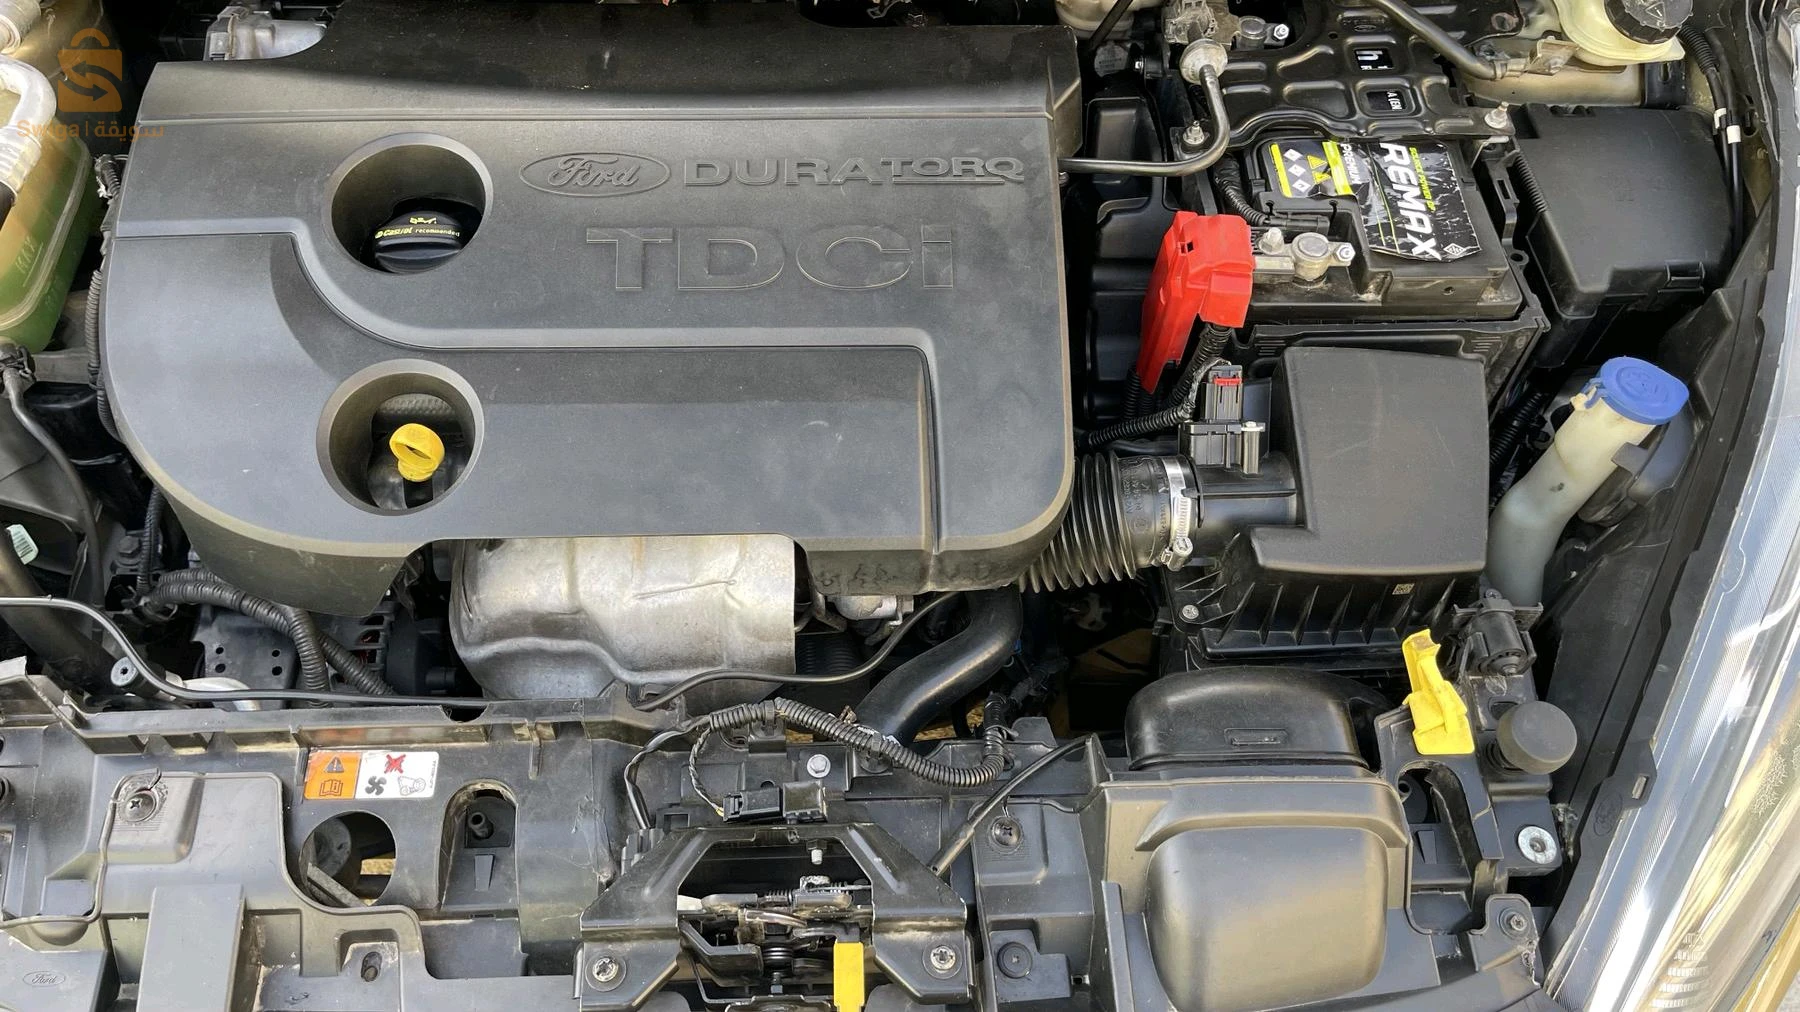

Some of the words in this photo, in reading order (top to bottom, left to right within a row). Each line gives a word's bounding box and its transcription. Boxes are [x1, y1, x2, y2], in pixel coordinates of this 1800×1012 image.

[547, 154, 641, 190] Ford
[683, 155, 1024, 186] DURATORQ
[1340, 143, 1364, 185] PREMIUM
[1380, 142, 1442, 261] REMAX
[383, 226, 413, 238] Castrol
[415, 227, 460, 238] recommended
[586, 223, 956, 291] TDCi
